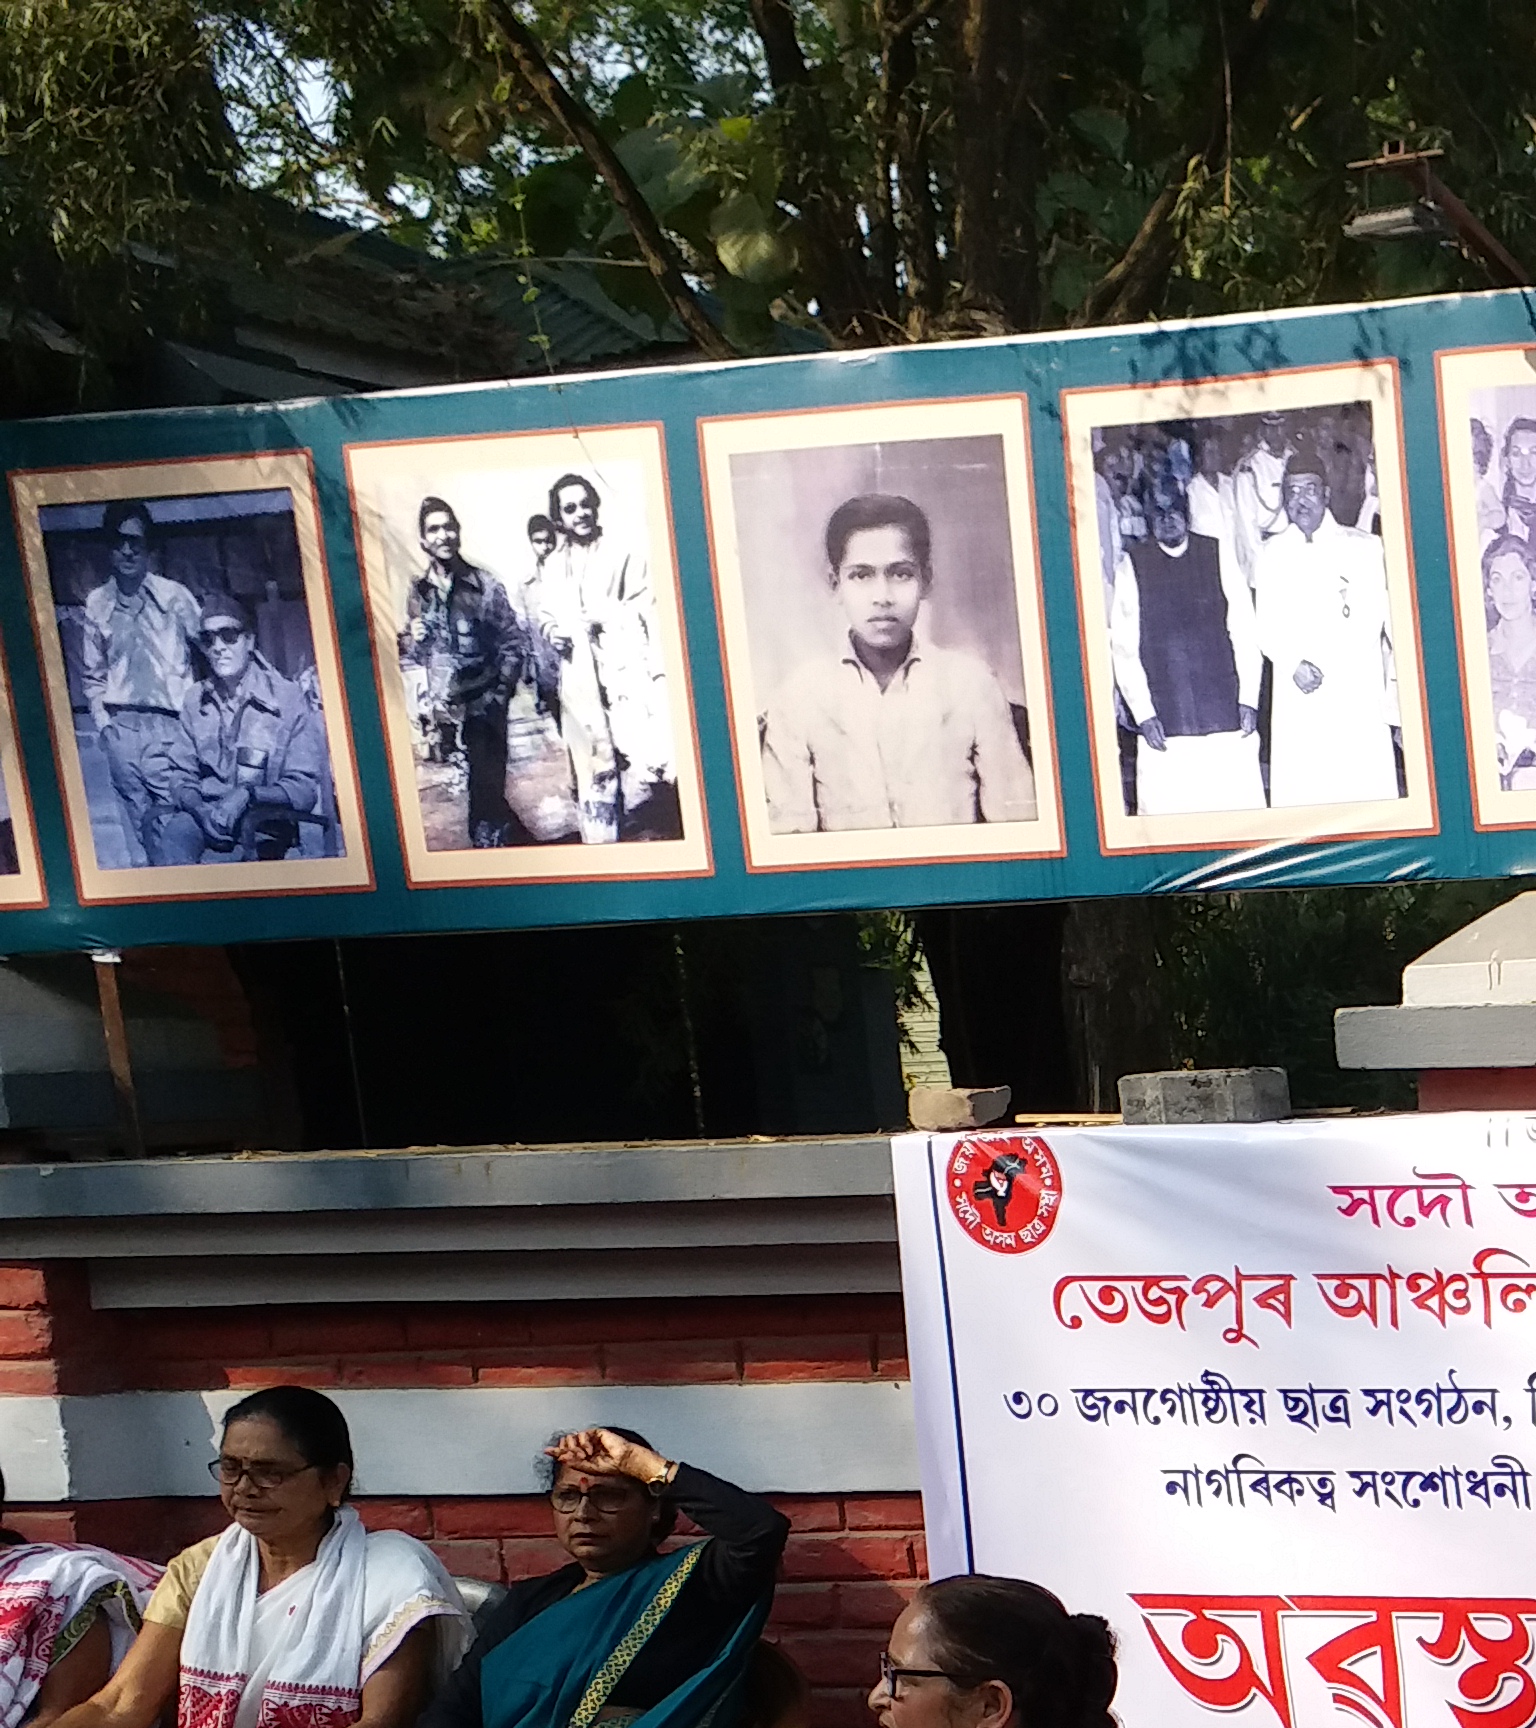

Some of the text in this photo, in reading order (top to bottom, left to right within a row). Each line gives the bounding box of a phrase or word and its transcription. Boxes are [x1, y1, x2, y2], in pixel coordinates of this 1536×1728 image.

[1326, 1166, 1476, 1228] সদৌ
[1053, 1265, 1298, 1349] তেজপুৰ
[1003, 1391, 1058, 1419] ৩০
[1360, 1370, 1512, 1431] সংগঠন,
[1160, 1453, 1336, 1513] নাগৰিকত্ব
[1345, 1455, 1532, 1510] সংশোধনী
